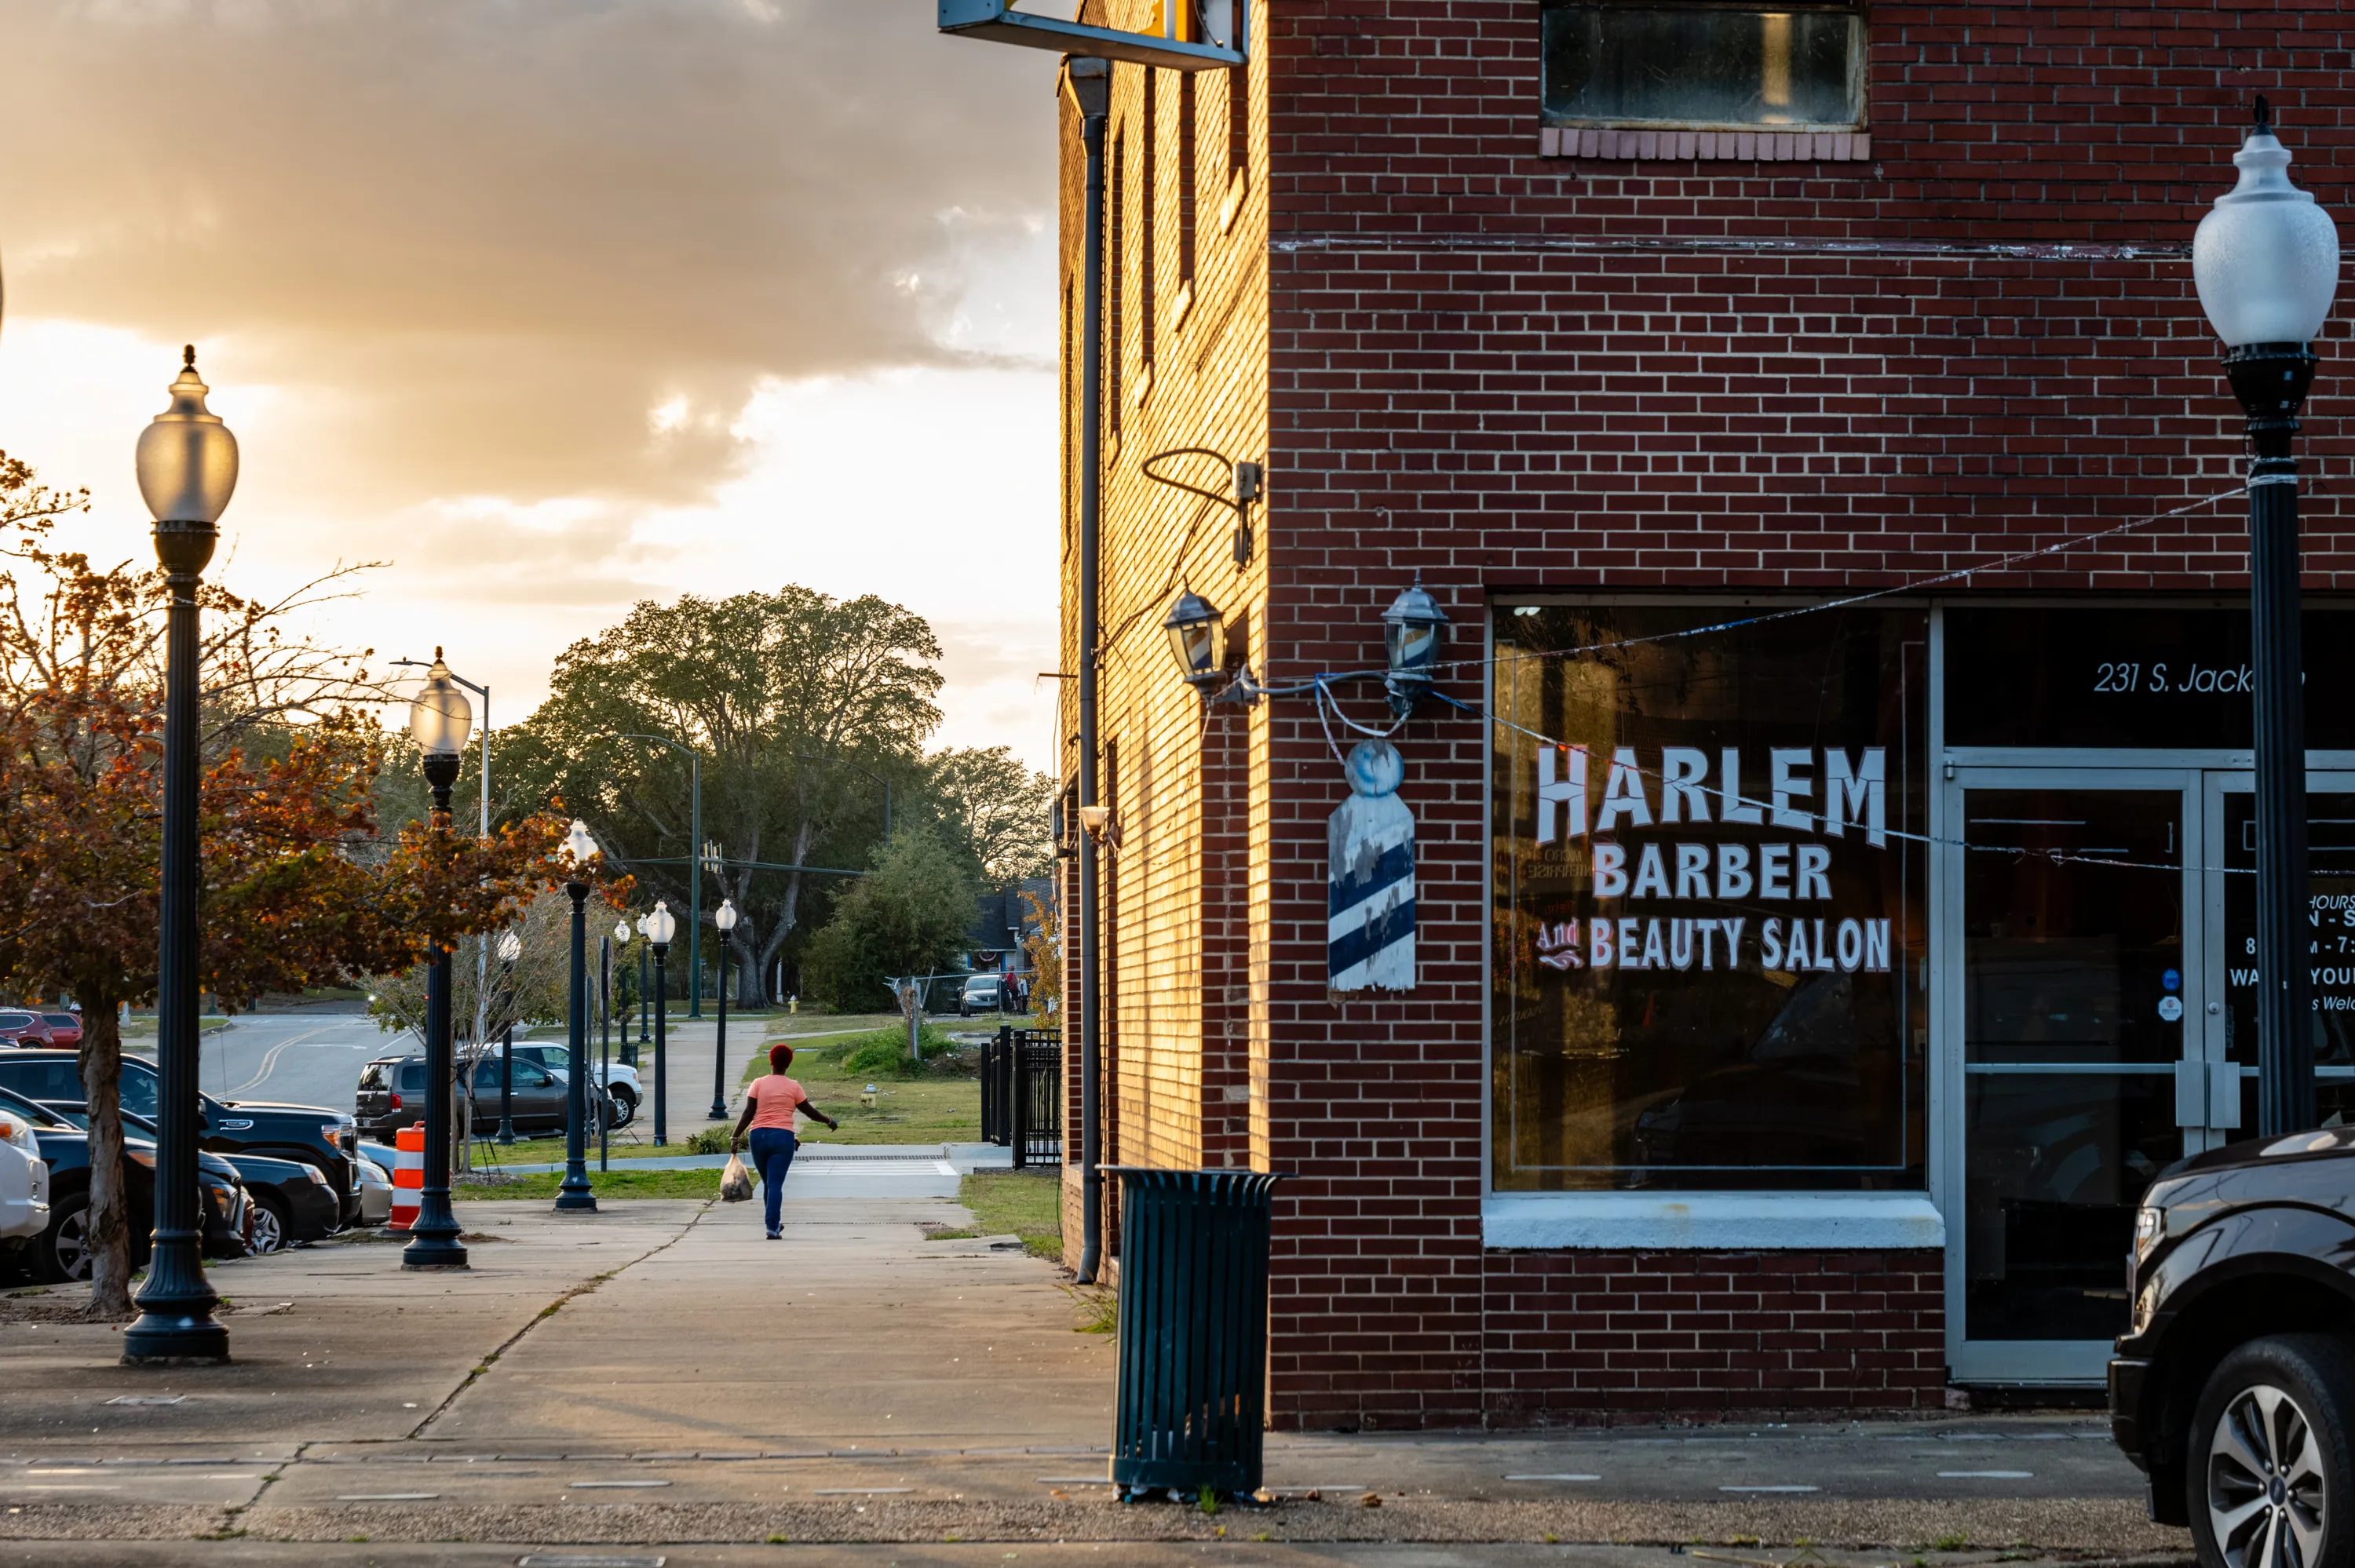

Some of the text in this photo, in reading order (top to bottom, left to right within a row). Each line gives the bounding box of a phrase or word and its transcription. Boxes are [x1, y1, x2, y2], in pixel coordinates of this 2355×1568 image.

[2094, 662, 2306, 693] 231 S. Jack
[1536, 744, 1888, 850] HARLEM
[1593, 842, 1834, 900] BARBER
[1536, 917, 1892, 974] And BEAUTY SALON
